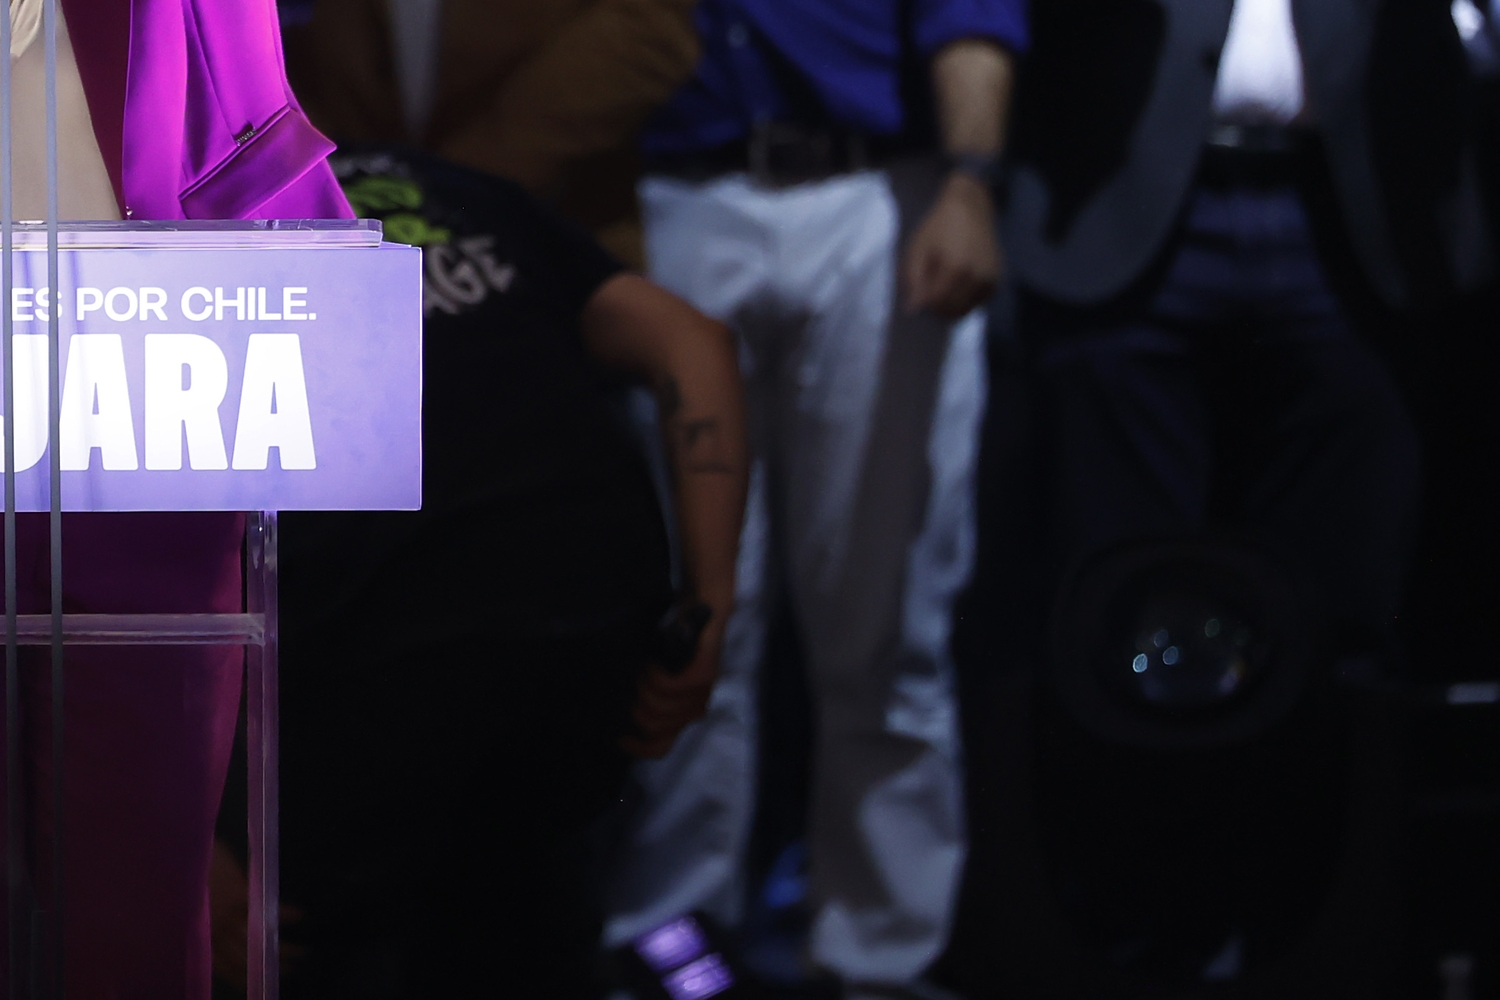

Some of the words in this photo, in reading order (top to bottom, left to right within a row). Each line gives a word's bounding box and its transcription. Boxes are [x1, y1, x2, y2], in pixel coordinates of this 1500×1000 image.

[11, 286, 64, 321] ES
[76, 286, 168, 320] POR
[180, 286, 316, 320] CHILE.
